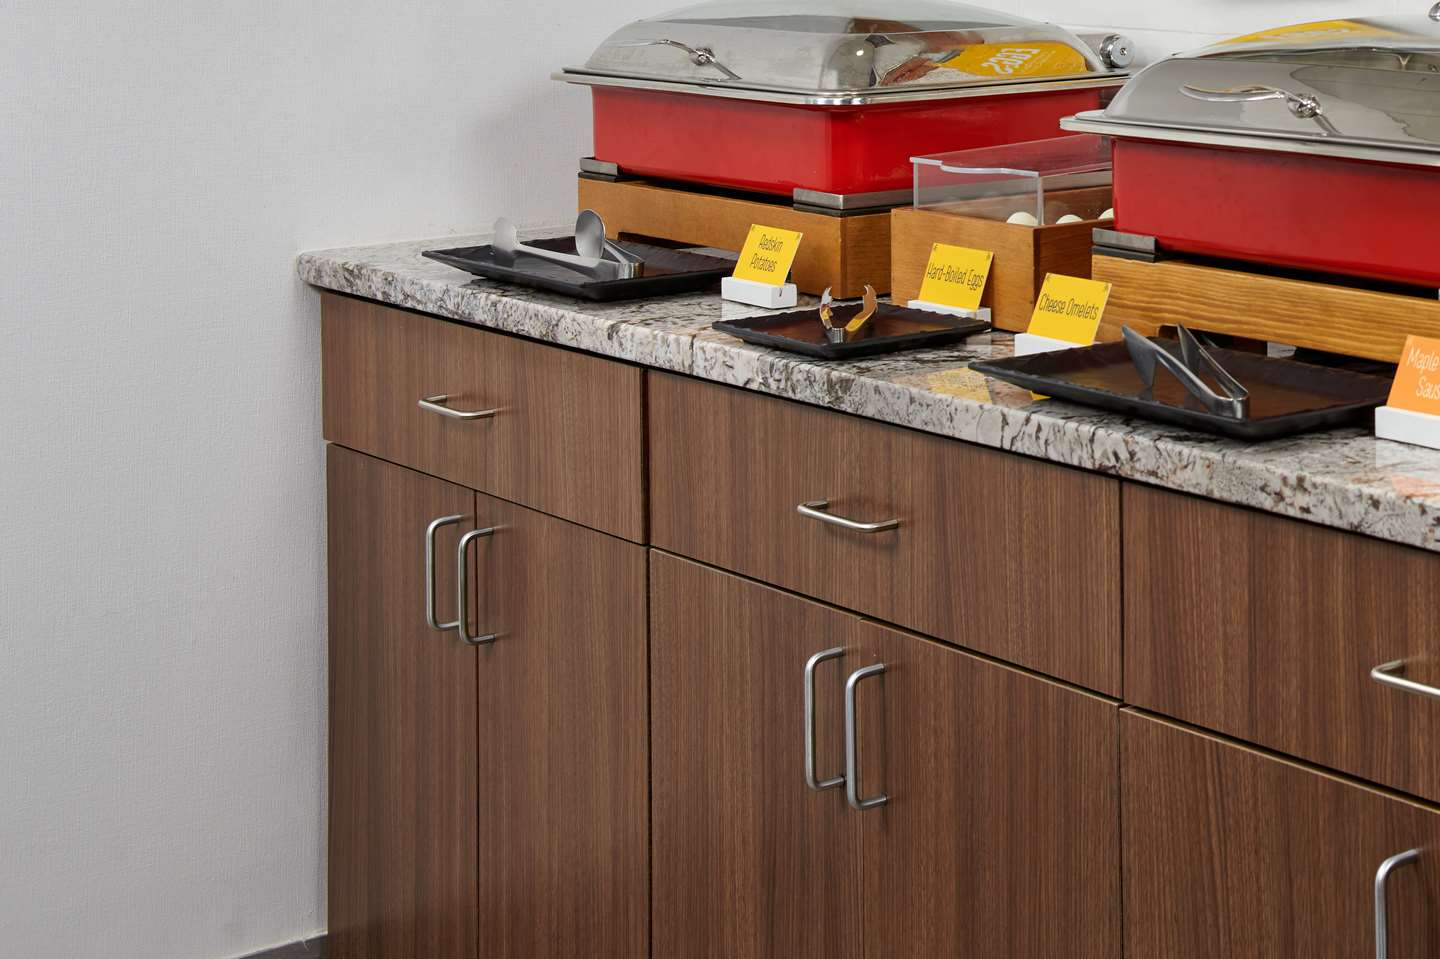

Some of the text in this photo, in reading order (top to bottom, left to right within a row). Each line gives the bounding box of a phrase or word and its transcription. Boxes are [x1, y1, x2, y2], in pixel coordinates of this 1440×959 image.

[927, 262, 985, 291] Hard-Boiled Eggs
[1039, 293, 1100, 320] Cheese Omelets
